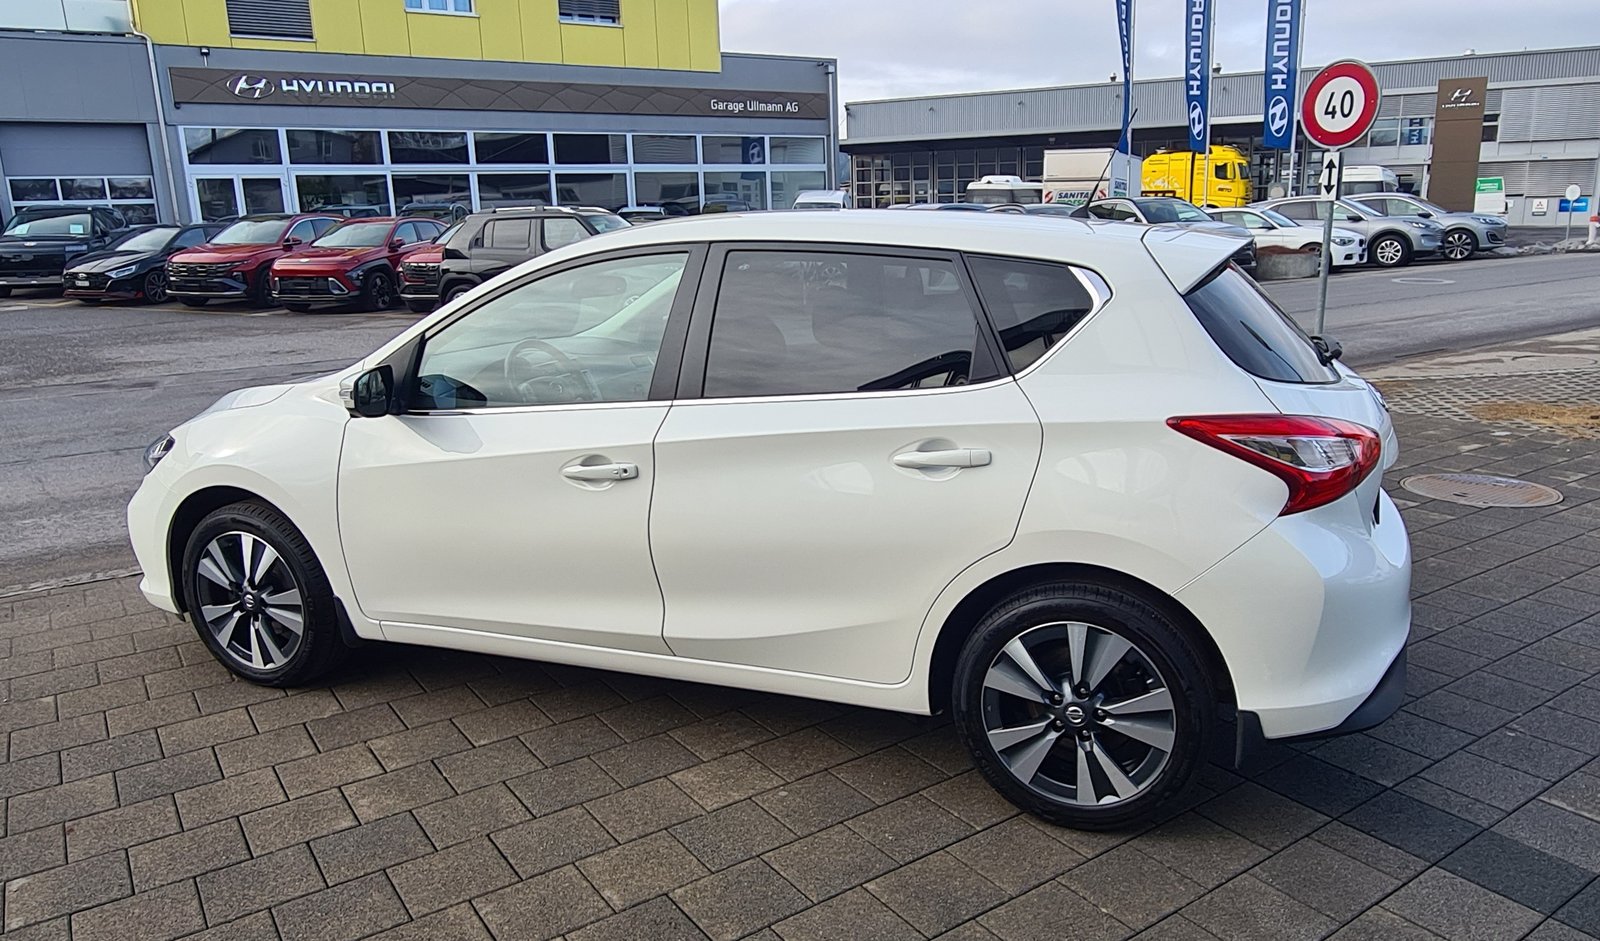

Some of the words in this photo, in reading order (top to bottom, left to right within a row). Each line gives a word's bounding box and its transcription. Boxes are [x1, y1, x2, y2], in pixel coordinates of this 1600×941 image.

[710, 99, 745, 113] Garage
[746, 100, 783, 112] Ullmann
[785, 101, 799, 112] AG
[1324, 89, 1355, 120] 40
